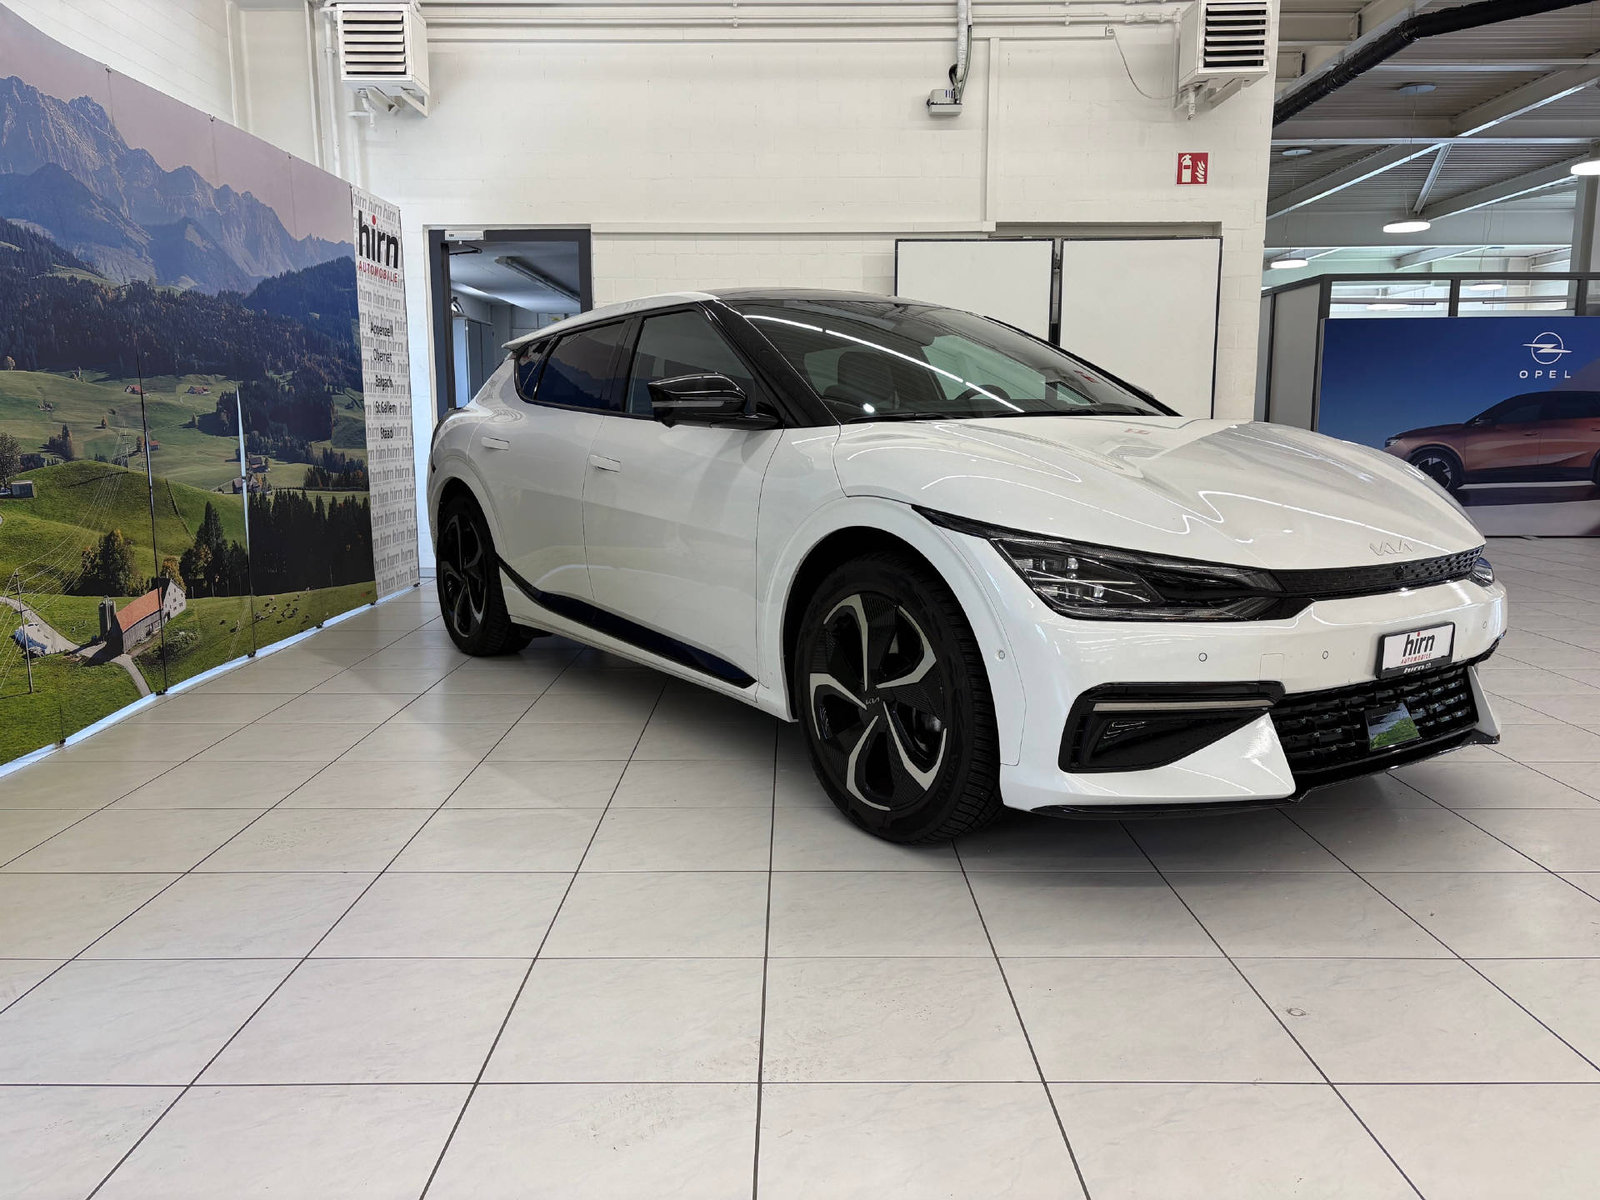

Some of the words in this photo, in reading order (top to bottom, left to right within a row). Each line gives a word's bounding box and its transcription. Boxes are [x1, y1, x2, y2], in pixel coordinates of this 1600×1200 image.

[358, 209, 399, 269] hirn
[358, 260, 399, 283] AUTOMOBILE
[1519, 370, 1572, 379] OPEL
[1402, 631, 1435, 657] hirn
